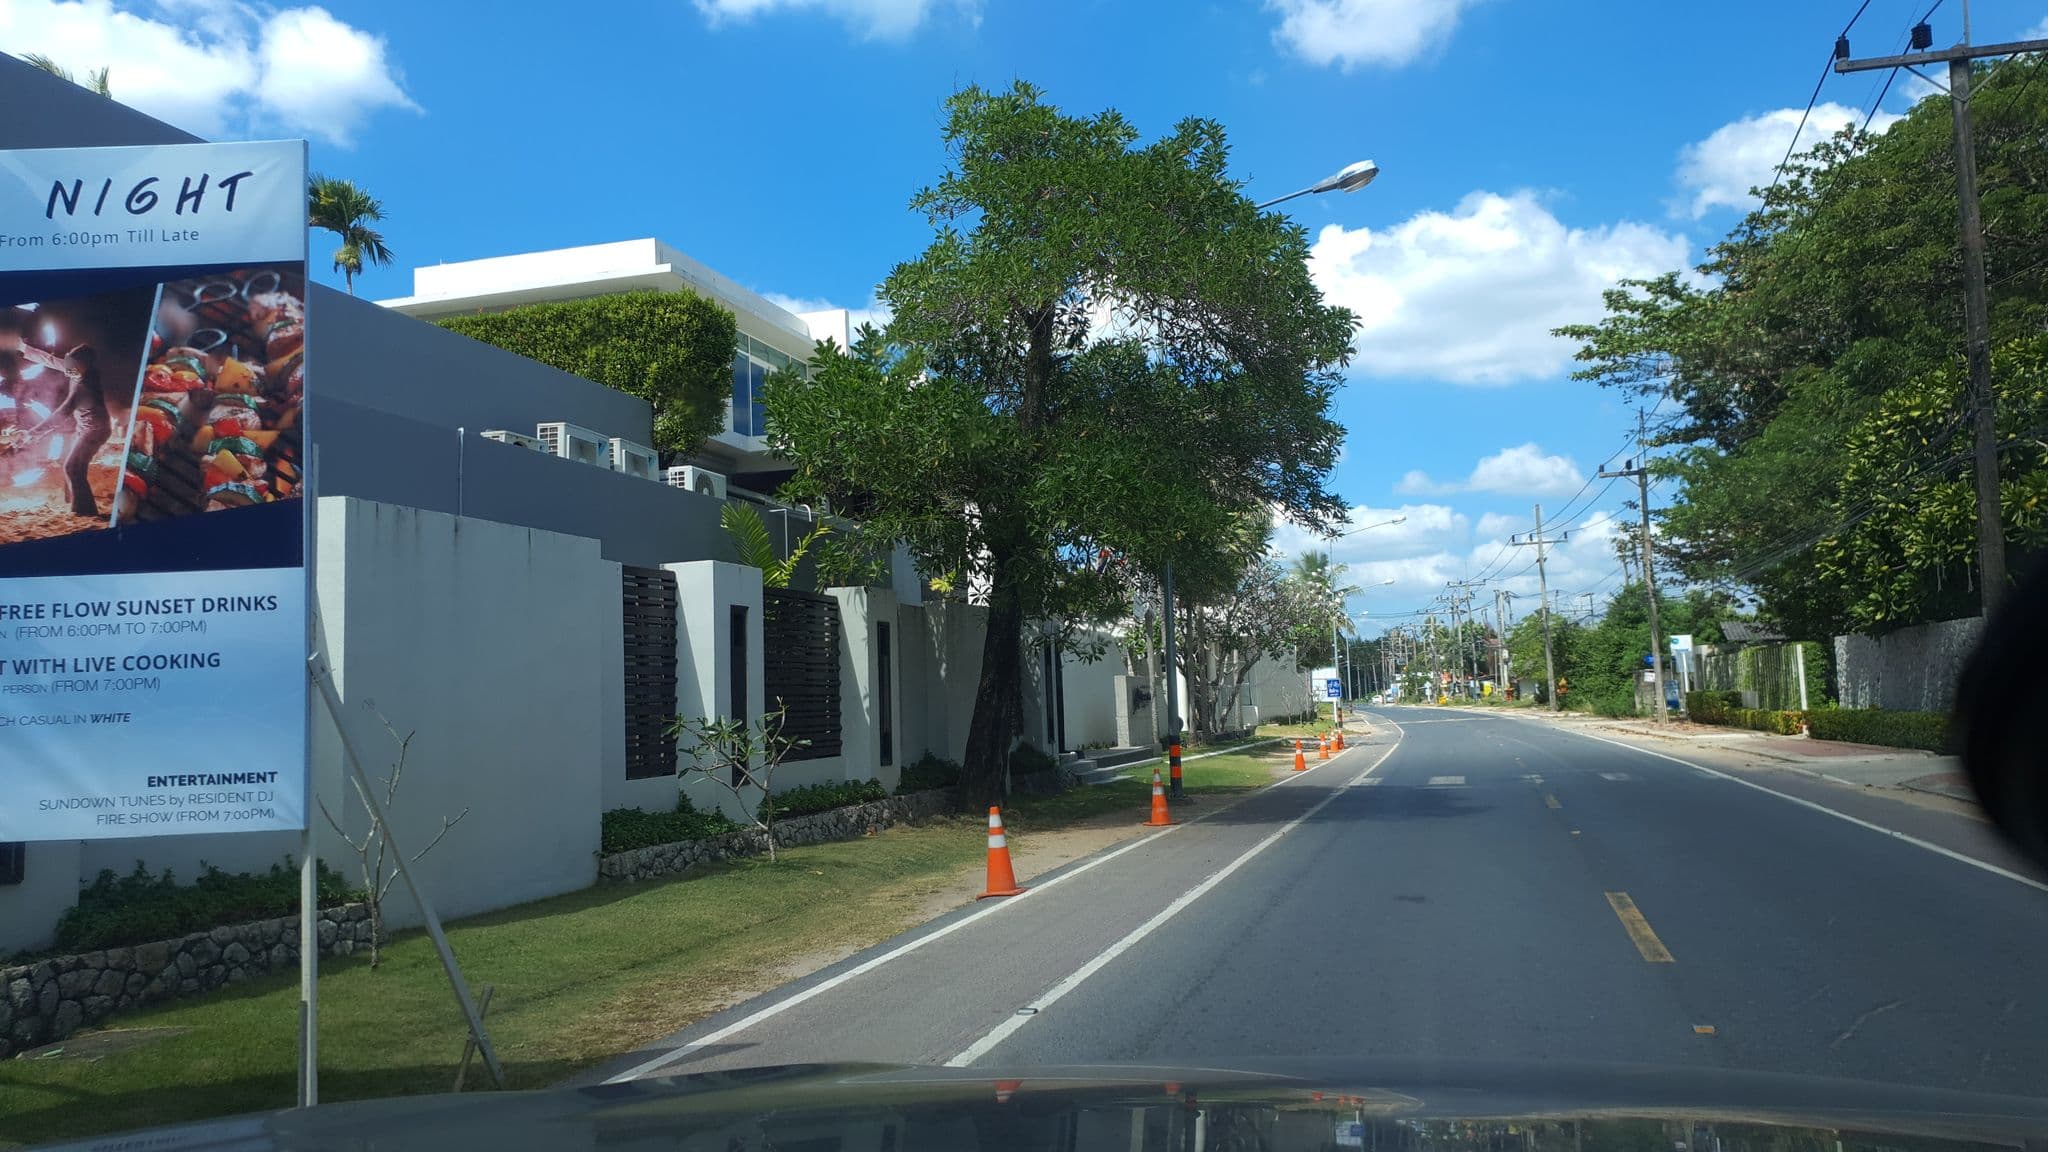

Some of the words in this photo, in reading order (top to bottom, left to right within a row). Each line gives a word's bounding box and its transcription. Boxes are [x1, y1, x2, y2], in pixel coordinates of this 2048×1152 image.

[46, 171, 254, 220] NIGHT
[0, 234, 44, 247] From
[52, 232, 119, 247] 6:00pm
[128, 229, 154, 243] Till
[162, 229, 200, 242] Late
[0, 604, 45, 620] FREE
[53, 601, 111, 618] FLOW
[116, 598, 195, 616] SUNSET
[202, 595, 278, 613] DRINKS
[15, 625, 63, 640] (FROM
[67, 623, 120, 637] 6:00PM
[125, 622, 145, 635] TO
[151, 620, 207, 635] 7:00PM)
[12, 658, 66, 675] WITH
[73, 656, 116, 672] LIVE
[122, 652, 221, 671] COOKING
[3, 684, 47, 694] PERSON
[51, 679, 99, 695] (FROM
[103, 677, 160, 692] 7:00PM)
[19, 714, 72, 726] CASUAL
[74, 714, 87, 724] IN
[90, 713, 132, 724] WHITE
[147, 771, 278, 788] ENTERTAINMENT
[39, 797, 116, 811] SUNDOWN
[119, 795, 166, 807] TUNES
[169, 794, 185, 807] by
[188, 792, 255, 805] RESIDENT
[258, 791, 274, 802] DJ
[97, 814, 125, 825] FIRE
[129, 812, 173, 824] SHOW
[176, 810, 220, 822] (FROM
